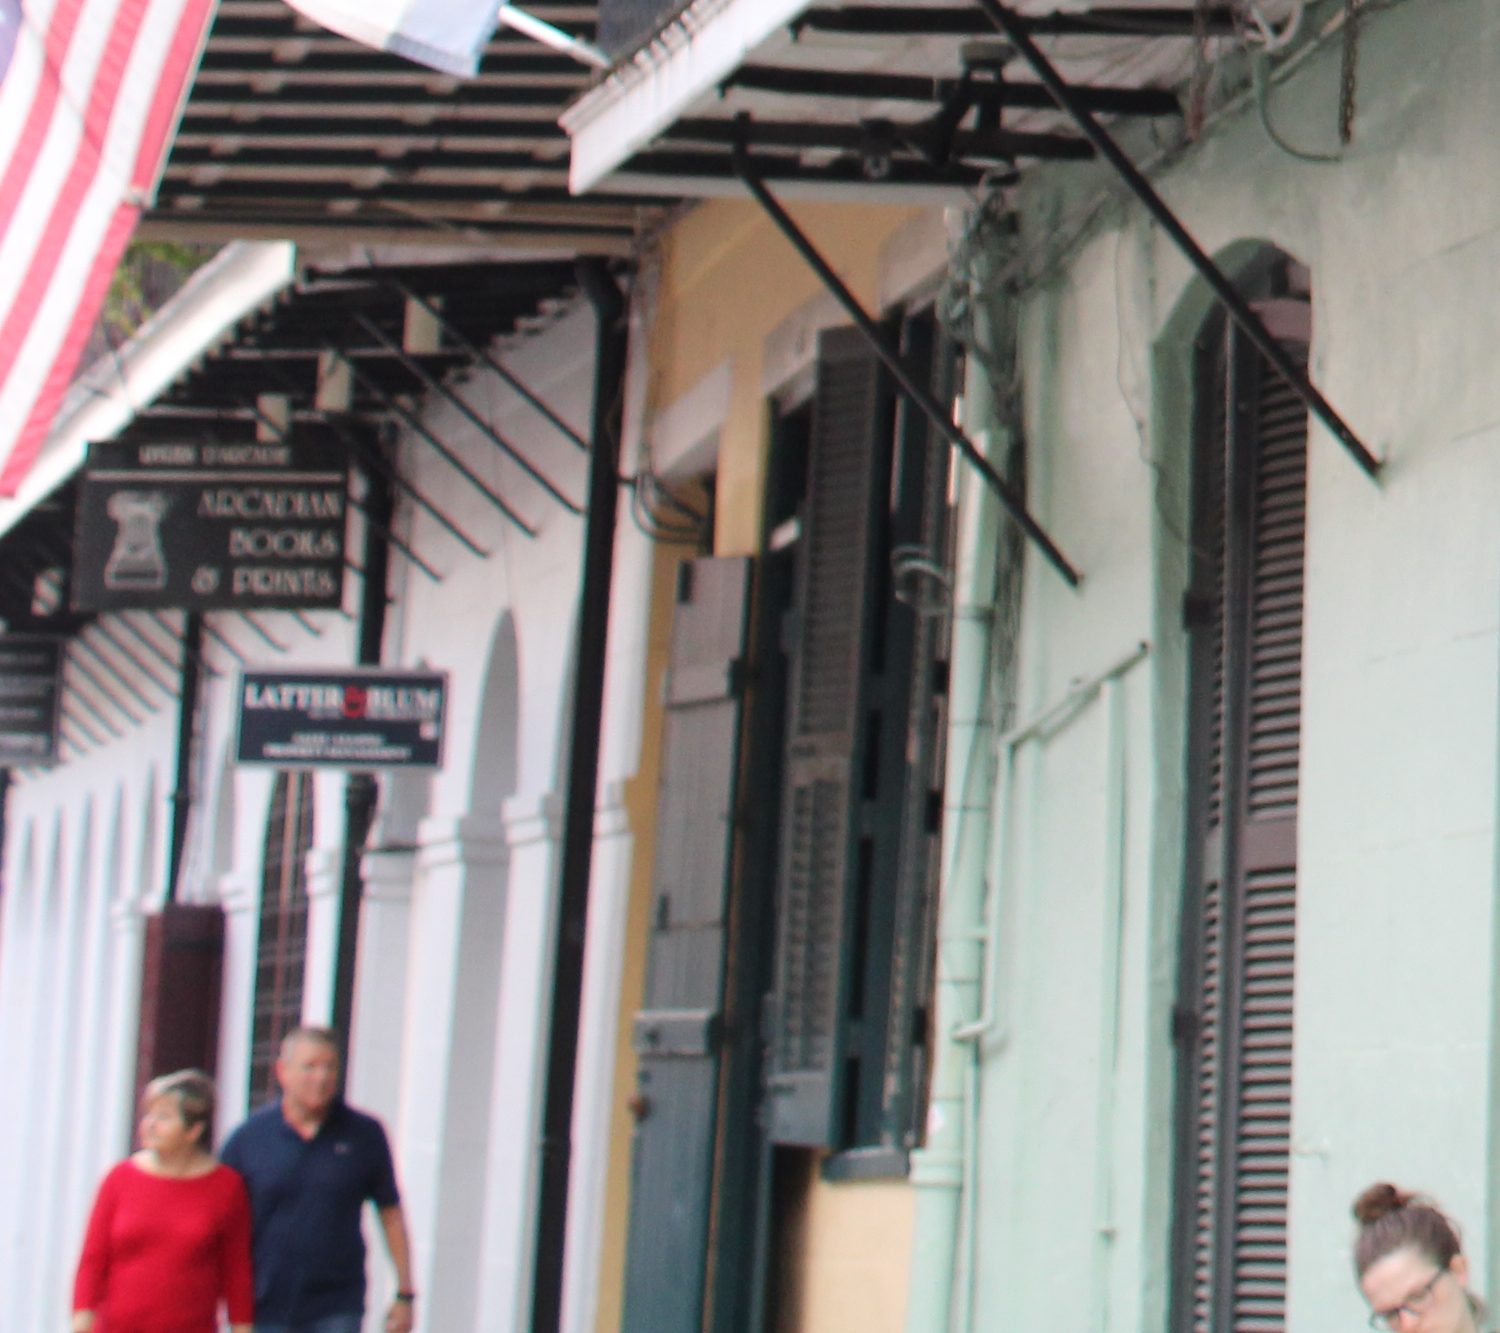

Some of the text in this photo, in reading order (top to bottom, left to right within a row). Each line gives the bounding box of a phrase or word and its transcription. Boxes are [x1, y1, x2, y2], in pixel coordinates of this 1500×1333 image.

[197, 489, 342, 518] ARCADIAN
[229, 528, 340, 557] BOOKS
[232, 566, 336, 596] PRINTS
